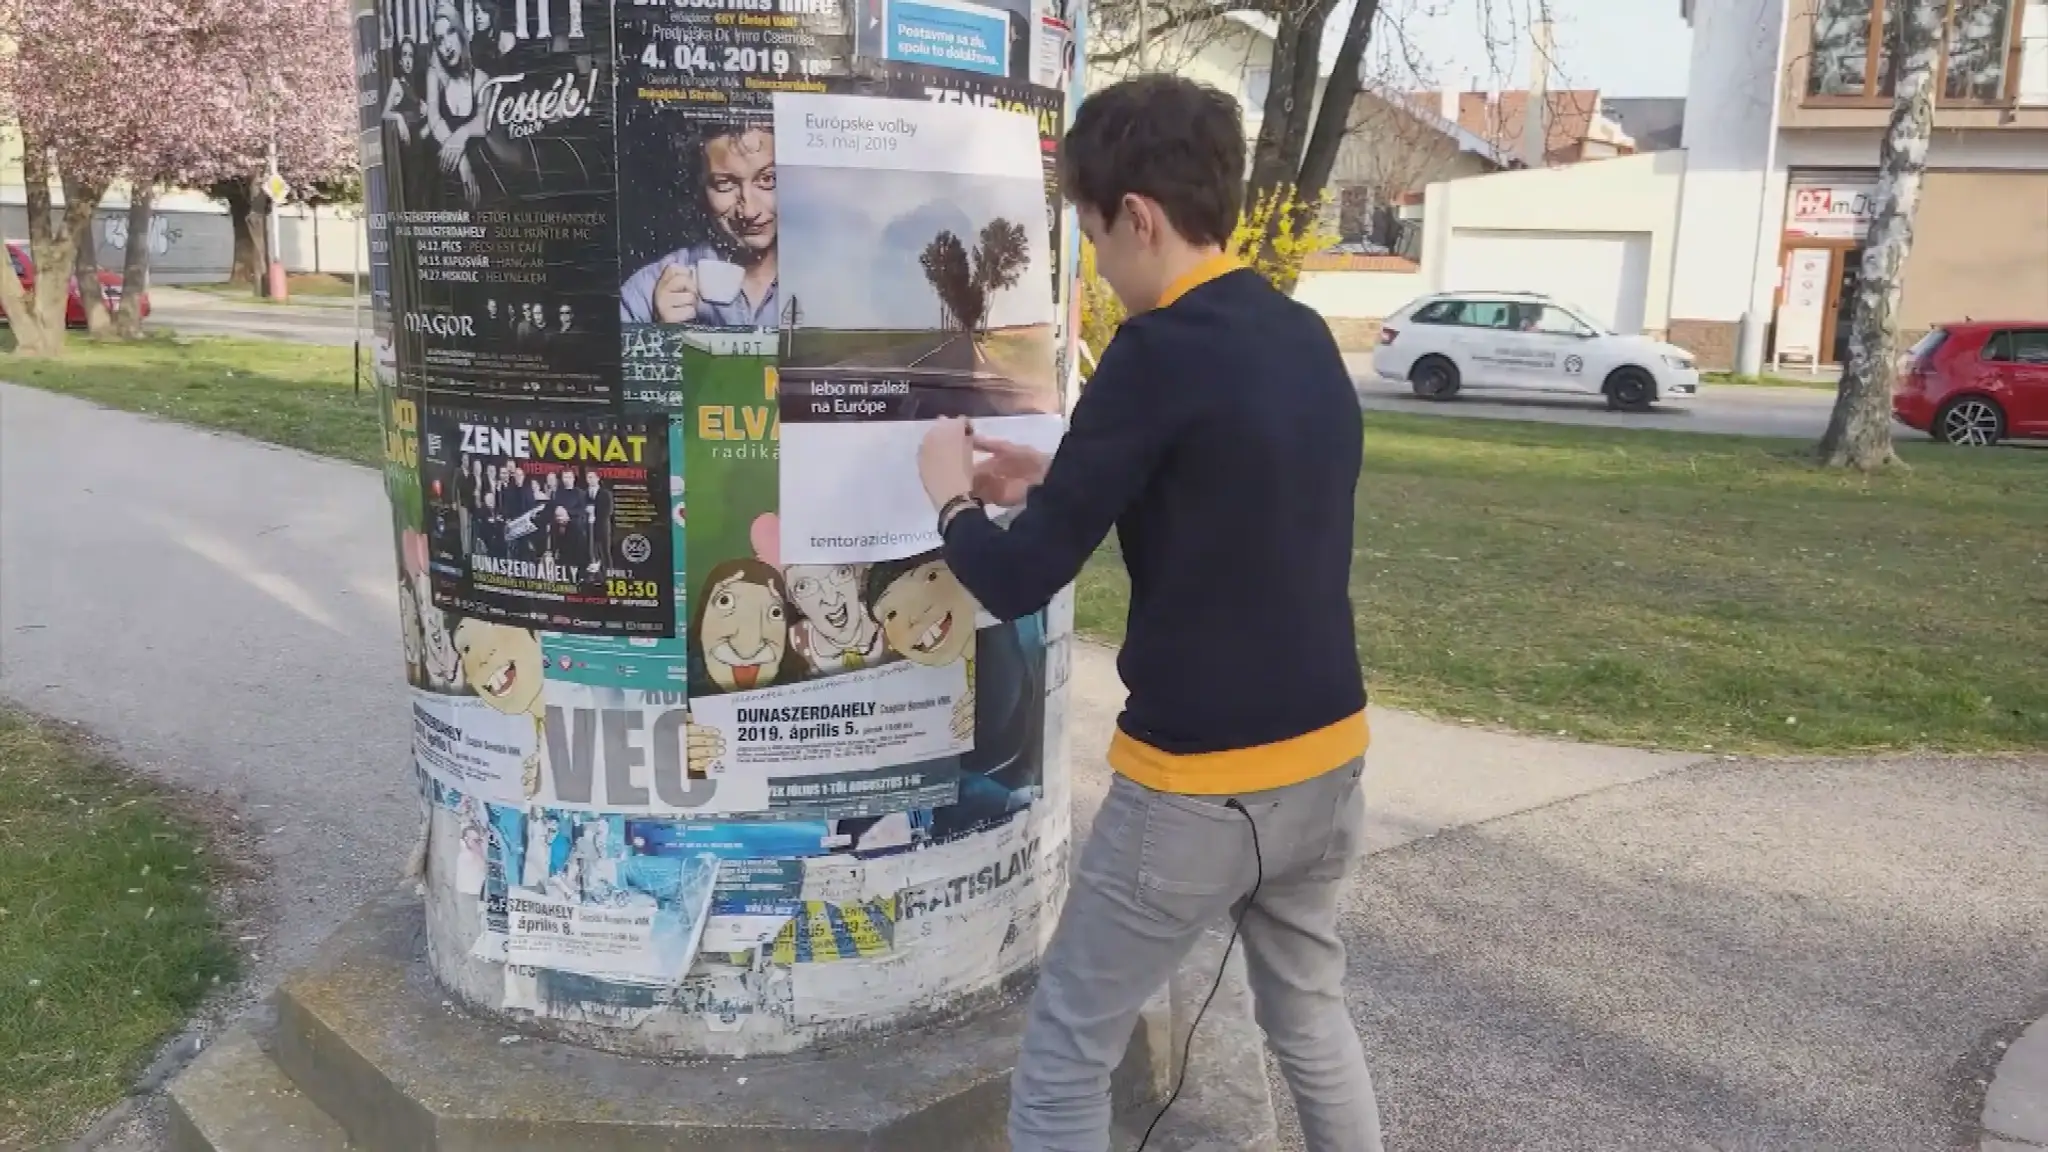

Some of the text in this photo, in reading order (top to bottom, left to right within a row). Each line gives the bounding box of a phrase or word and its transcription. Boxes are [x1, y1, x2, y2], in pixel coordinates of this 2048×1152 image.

[641, 43, 666, 69] 4.
[674, 44, 716, 71] 04.
[723, 47, 790, 74] 2019
[932, 45, 944, 57] to
[477, 68, 598, 131] Tessék!
[806, 113, 875, 133] Európske
[806, 133, 827, 149] 25.
[864, 136, 898, 151] 2019
[404, 311, 476, 339] MAGOR
[810, 380, 846, 396] lebo
[849, 380, 868, 395] mi
[811, 399, 887, 415] na Európe
[459, 422, 648, 462] ZENEVONAT
[605, 580, 657, 597] 18:30
[737, 702, 876, 723] DUNASZERDAHELY
[737, 726, 784, 742] 2019.
[789, 723, 839, 743] április
[845, 721, 859, 736] 5.
